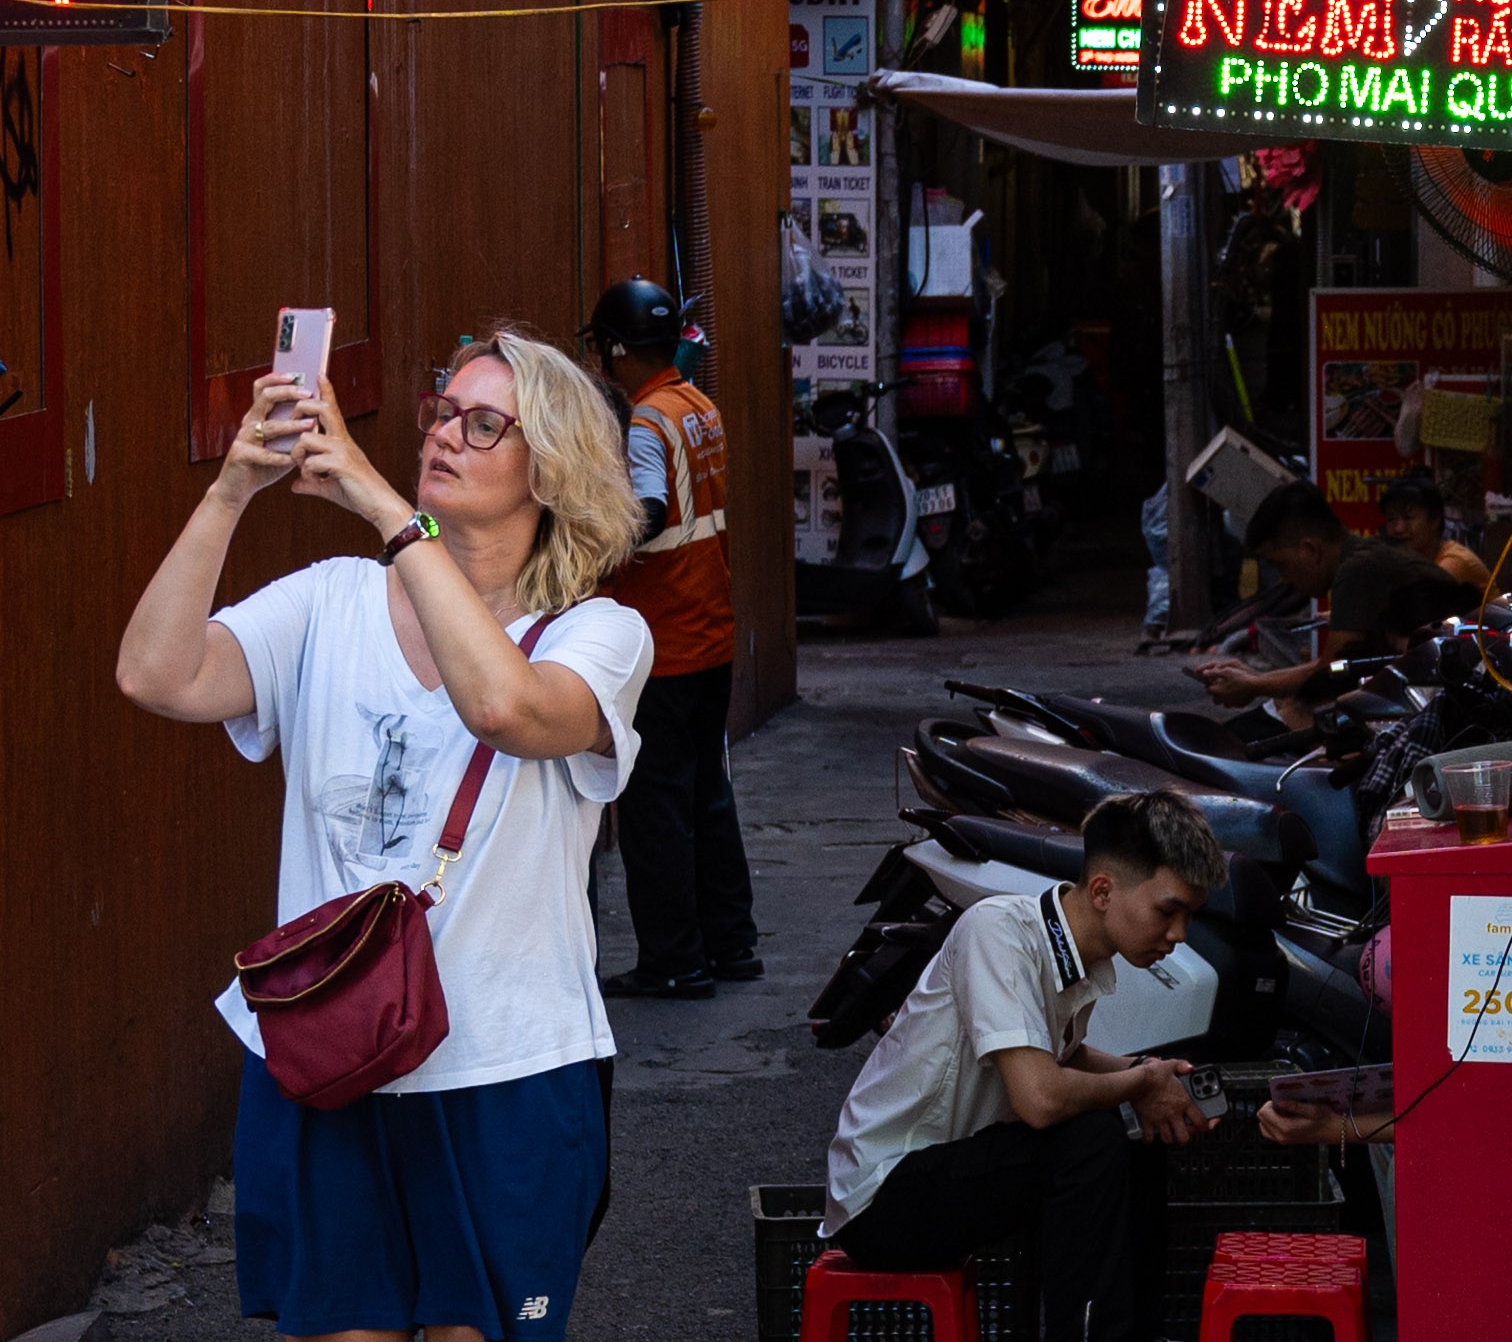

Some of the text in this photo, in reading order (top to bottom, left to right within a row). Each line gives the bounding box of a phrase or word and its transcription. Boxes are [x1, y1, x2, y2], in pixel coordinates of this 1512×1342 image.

[1221, 58, 1330, 106] PHO
[1340, 66, 1431, 114] MAI
[843, 177, 870, 191] TICKET
[818, 356, 868, 369] BICYCLE
[1462, 954, 1480, 965] XE
